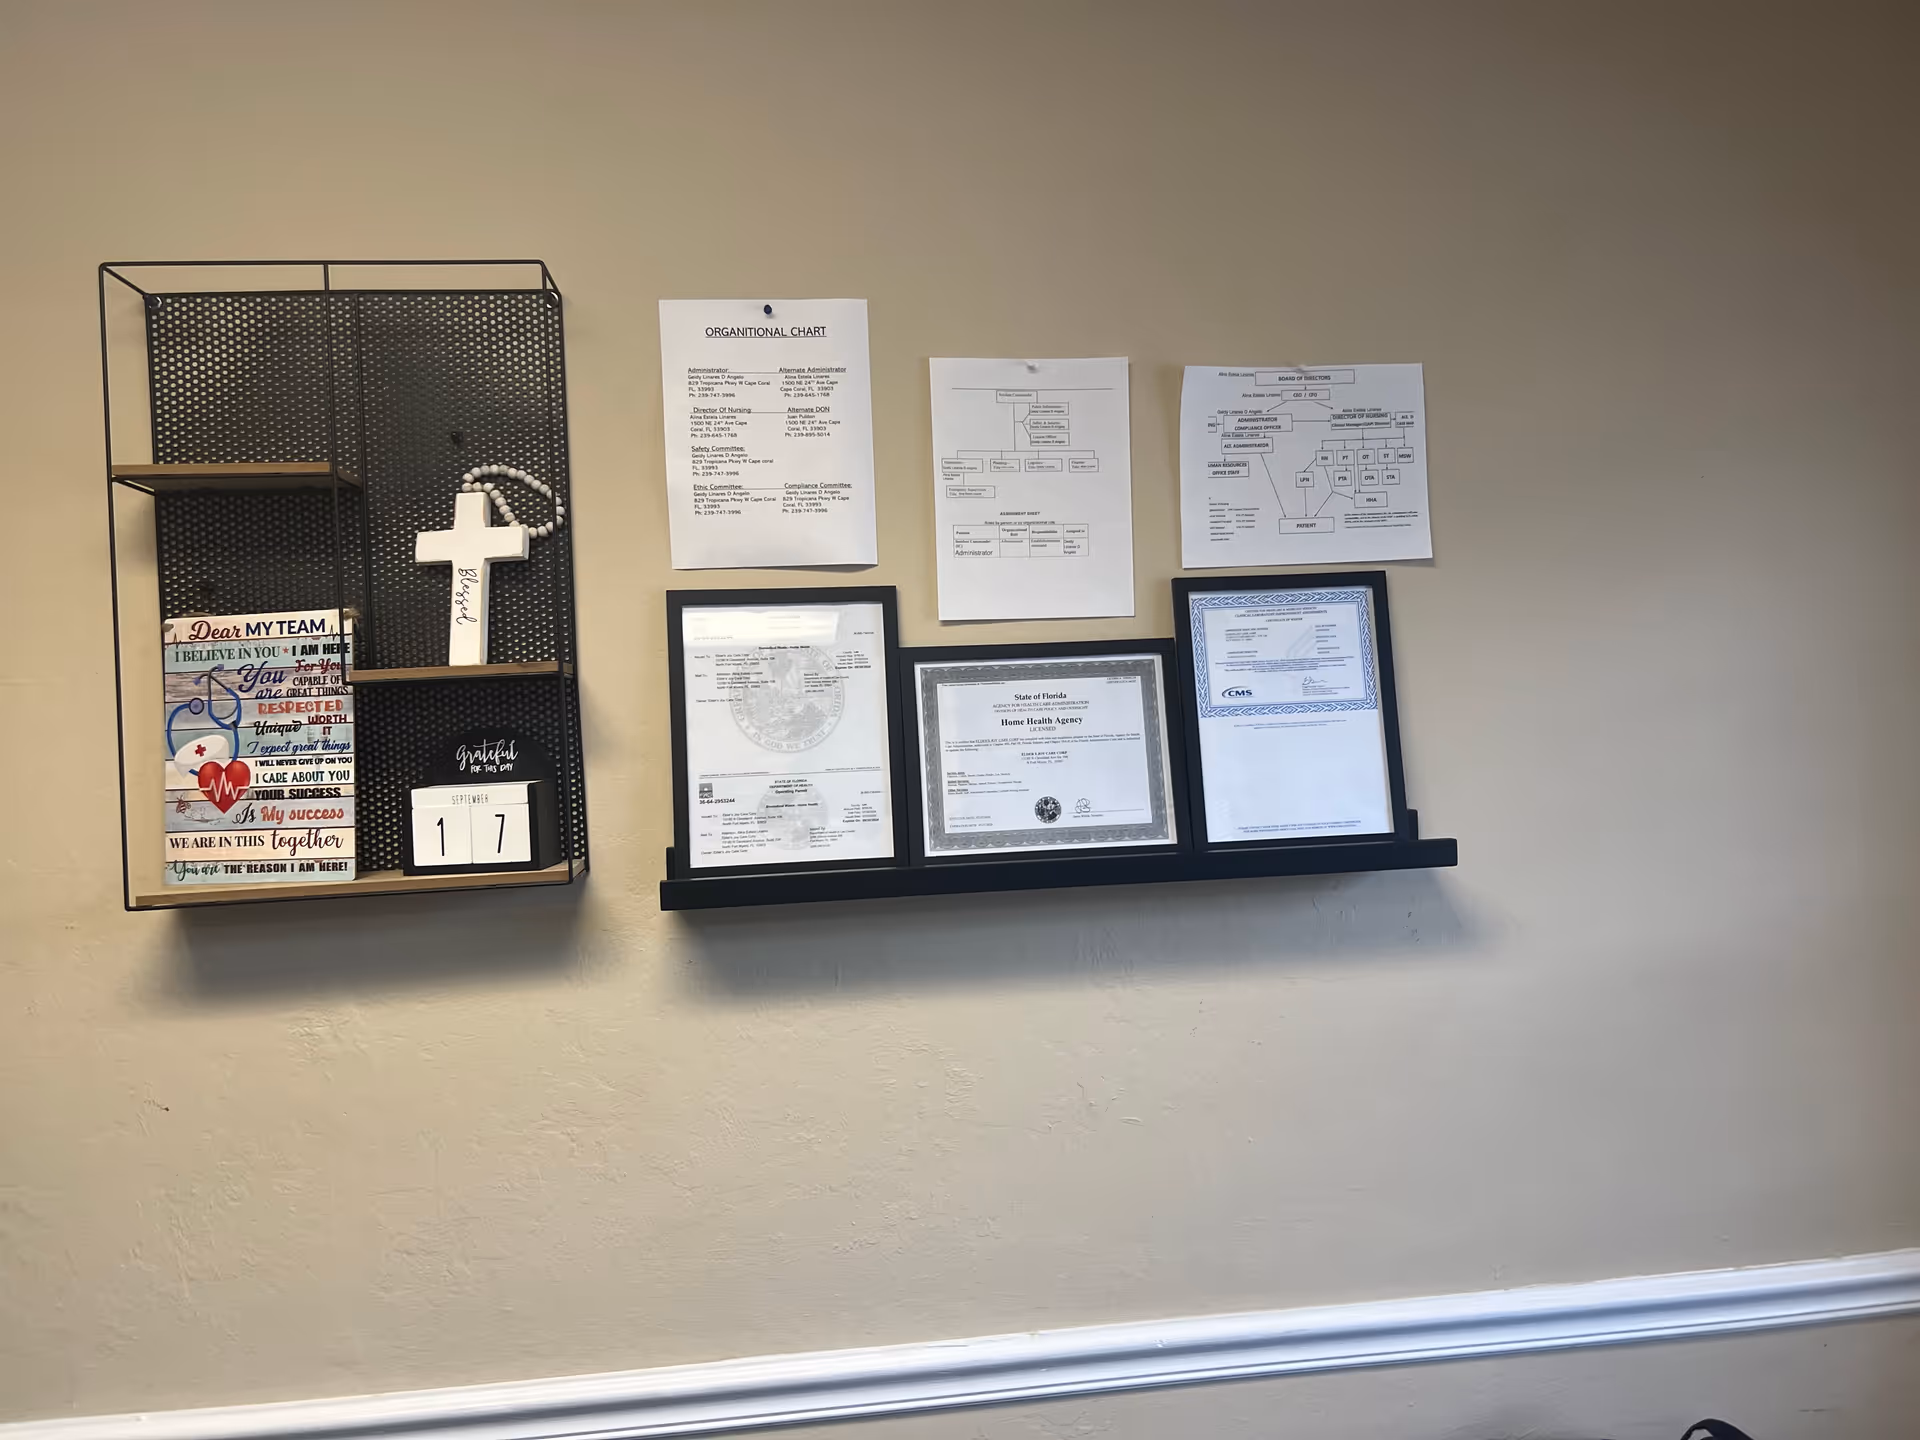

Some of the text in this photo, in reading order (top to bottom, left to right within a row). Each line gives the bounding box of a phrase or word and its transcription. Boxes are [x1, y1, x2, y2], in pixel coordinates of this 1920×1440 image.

[705, 326, 826, 336] ORGANITIONAL CHART
[454, 568, 479, 626] Blessed
[188, 618, 326, 640] Dear MY TEAM
[175, 646, 281, 662] I BELIEVE IN YOU
[292, 645, 296, 656] I
[300, 644, 318, 656] AM
[294, 659, 316, 672] For
[237, 661, 288, 692] You
[292, 674, 342, 686] CAPABLE OF
[254, 688, 283, 699] are
[286, 686, 348, 698] GREAT THINGS
[1228, 689, 1252, 697] CMS
[258, 700, 344, 715] RESPECTED
[308, 714, 348, 724] WORTH
[1026, 717, 1052, 725] Health
[1054, 716, 1082, 724] Agency
[254, 720, 302, 736] Unique
[322, 726, 332, 736] IT
[246, 738, 352, 756] I expect great things
[470, 762, 514, 774] FOR THIS DAY
[262, 772, 288, 783] CARE
[292, 771, 325, 782] ABOUT
[328, 770, 350, 780] YOU
[254, 787, 342, 800] YOUR SUCCESS
[452, 794, 488, 804] SEPTEMBER
[232, 803, 344, 824] Is My success
[437, 817, 445, 856] 1
[494, 814, 505, 854] 7
[170, 829, 344, 856] WE ARE IN THIS together
[170, 860, 348, 881] You are THE REASON I AM HERE!
